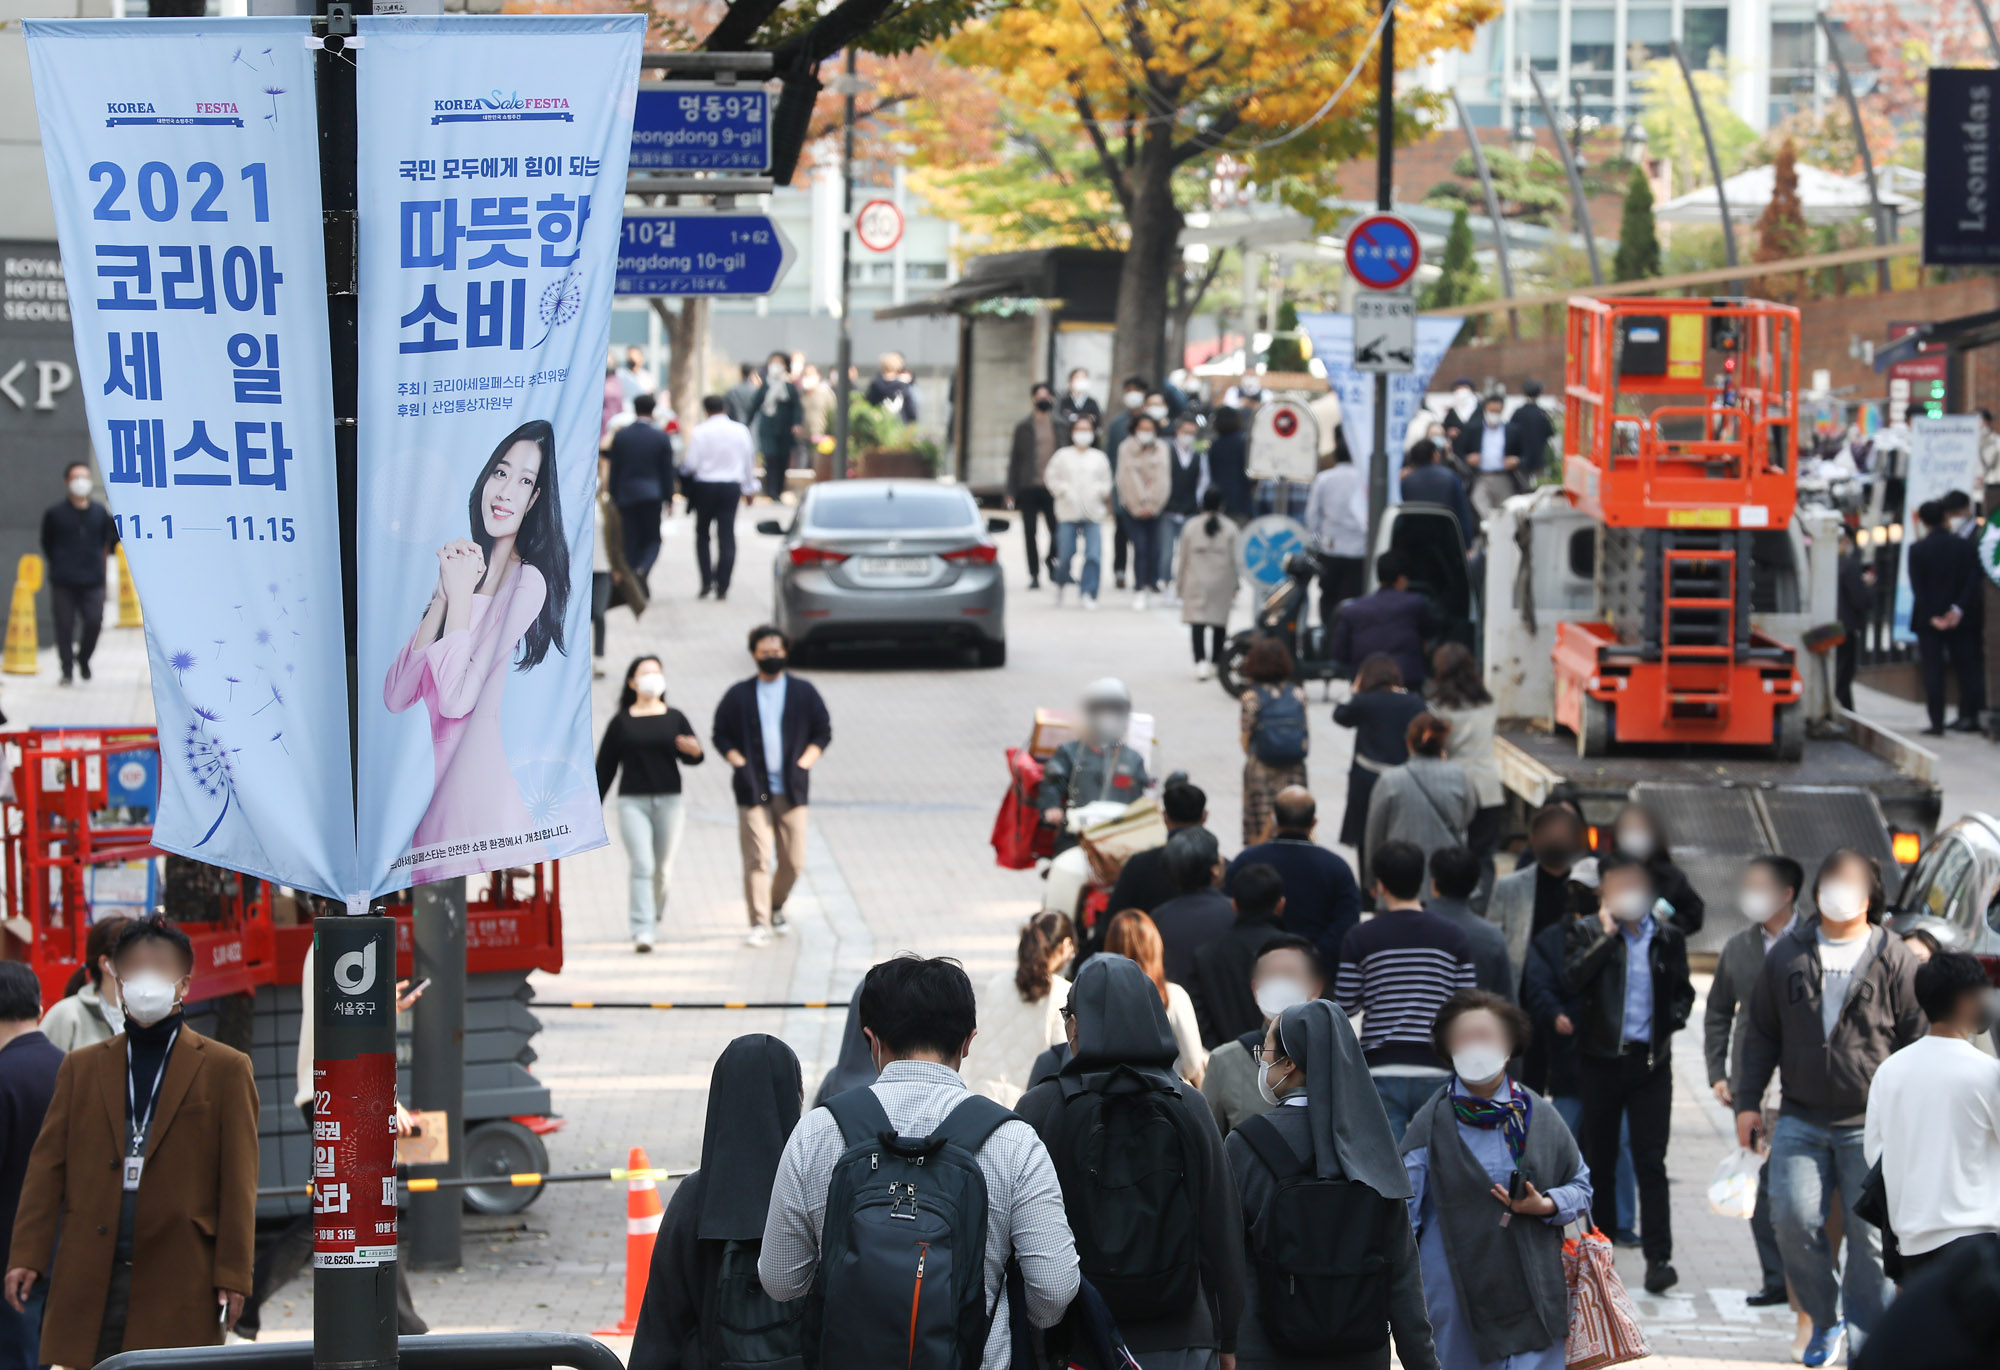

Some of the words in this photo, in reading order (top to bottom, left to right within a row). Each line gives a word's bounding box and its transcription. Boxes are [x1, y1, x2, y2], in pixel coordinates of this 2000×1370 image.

[107, 103, 156, 113] KOREA
[196, 103, 239, 113] FESTA
[434, 100, 482, 110] KOREA
[476, 89, 525, 110] Sale
[525, 98, 570, 109] FESTA
[679, 95, 762, 122] 명동9길
[631, 127, 719, 147] eongdong
[722, 127, 762, 147] 9-gil
[399, 160, 436, 181] 국민
[442, 157, 518, 179] 모두에게
[524, 156, 562, 177] 힘이
[568, 156, 600, 177] 되는
[1958, 85, 1991, 231] Leonidas
[89, 161, 270, 222] 2021
[400, 193, 592, 271] 따뜻한
[619, 220, 676, 248] 10길
[616, 252, 691, 273] ongdong
[696, 252, 746, 273] 10-gil
[95, 245, 283, 315] 코리아
[3, 301, 71, 321] SEOUL
[399, 279, 526, 354] 소비
[104, 332, 163, 401] 세
[227, 332, 283, 404] 일
[34, 360, 73, 410] P
[397, 382, 420, 397] 주최
[432, 376, 525, 394] 코리아세일페스타
[528, 367, 570, 387] 추진위원
[397, 402, 420, 417] 후원
[432, 396, 513, 415] 산업통상자원부
[107, 419, 293, 491] 페스타
[226, 516, 295, 542] 11.15
[447, 843, 471, 858] 안전한
[472, 839, 488, 853] 쇼핑
[489, 835, 523, 850] 환경에서
[524, 824, 572, 843] 개최합니다.
[334, 1001, 376, 1015] 서울중구
[313, 1090, 331, 1115] 22
[313, 1121, 340, 1140] 원권
[313, 1146, 335, 1177] 일
[313, 1182, 351, 1213] 스타
[319, 1229, 334, 1240] 10월
[337, 1229, 356, 1240] 31일
[375, 1222, 391, 1233] 10월
[324, 1255, 376, 1264] 02.6250.
